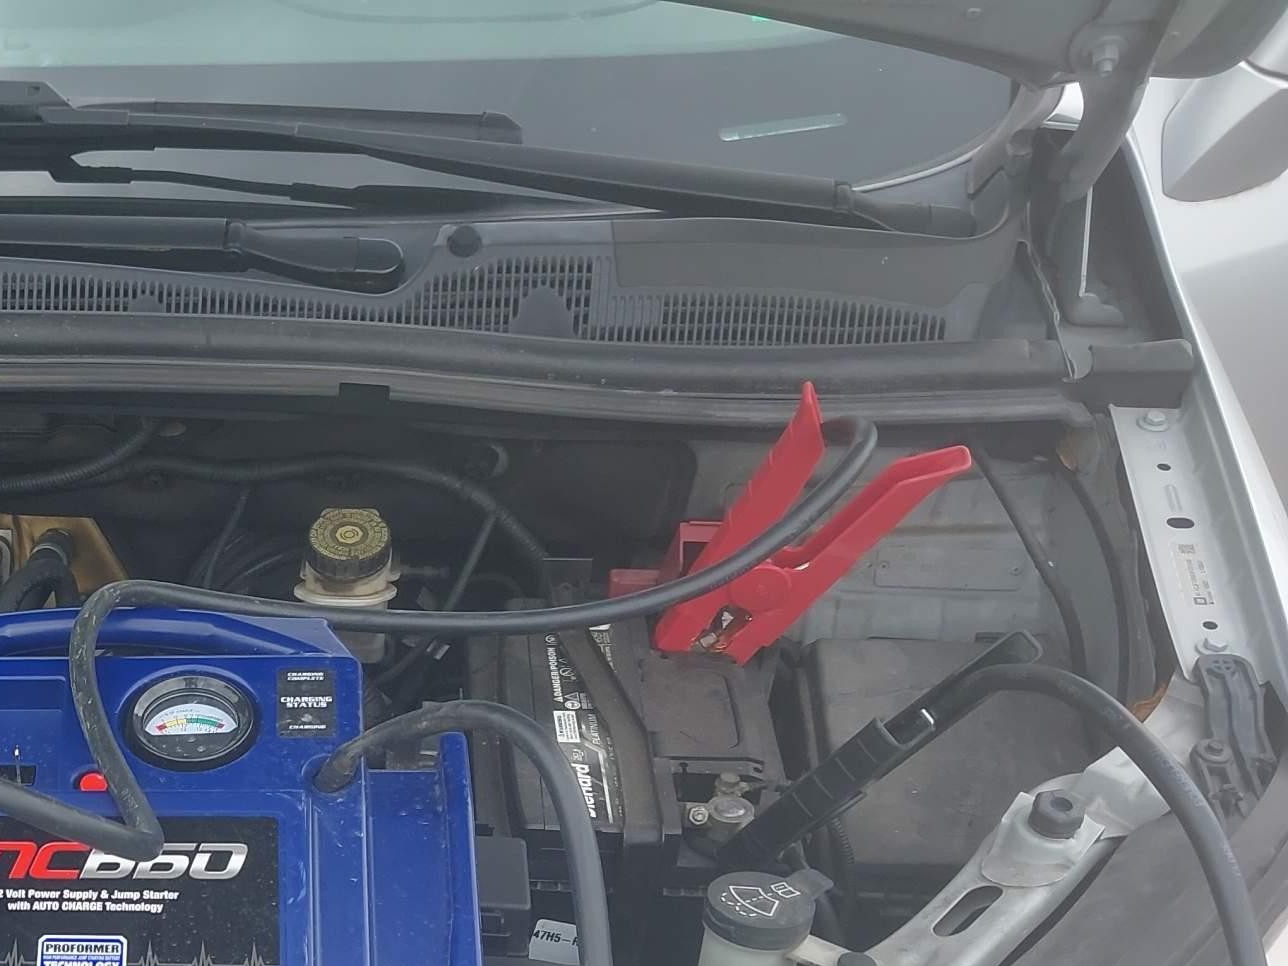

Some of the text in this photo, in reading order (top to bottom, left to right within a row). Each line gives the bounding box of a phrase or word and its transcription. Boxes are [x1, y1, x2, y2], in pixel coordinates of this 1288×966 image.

[5, 889, 26, 898] Volt
[28, 889, 60, 899] Power
[62, 889, 98, 901] Supply
[100, 890, 109, 899] &
[111, 890, 141, 901] Jump
[142, 890, 179, 900] Starter
[7, 901, 164, 913] with AUTO CHARGE Technology
[45, 943, 120, 954] PROFORMER
